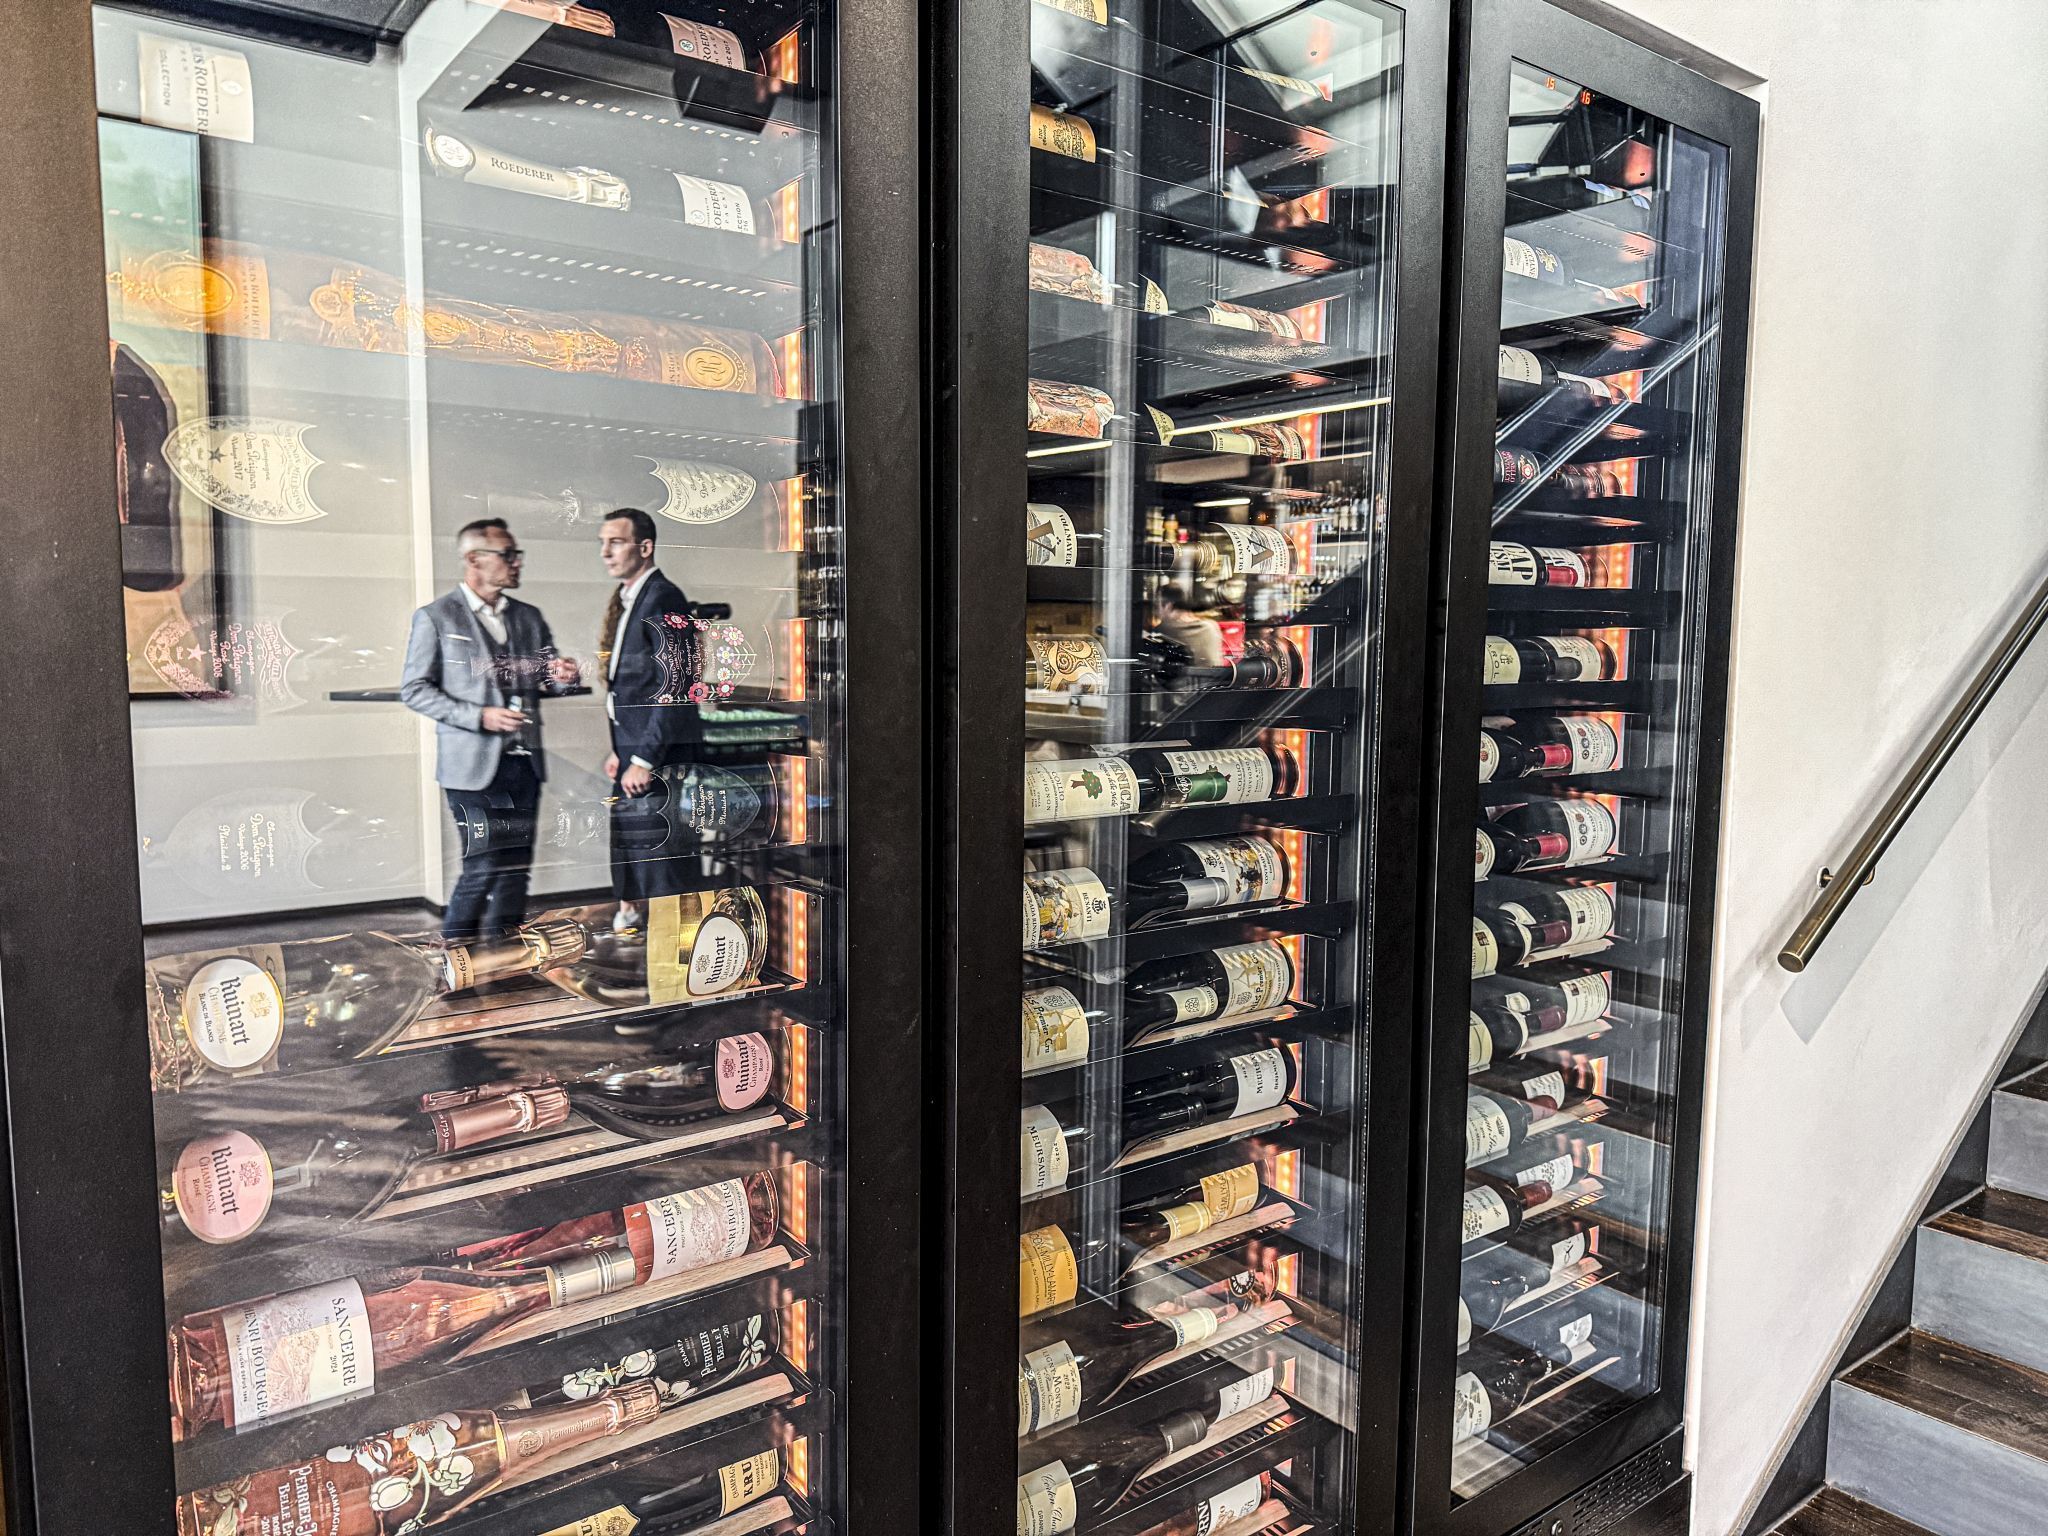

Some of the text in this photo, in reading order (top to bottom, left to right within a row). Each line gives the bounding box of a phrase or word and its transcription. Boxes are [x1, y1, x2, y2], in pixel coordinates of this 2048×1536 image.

[159, 49, 171, 106] COLLECTION
[1580, 91, 1591, 104] 16
[491, 157, 555, 182] ROEDERER
[234, 460, 244, 481] 2017
[1059, 514, 1075, 566] VOLLMAYER
[1501, 545, 1533, 580] CAP
[229, 623, 243, 645] Dom
[245, 630, 255, 676] Champagne
[693, 663, 702, 682] Dom
[1051, 771, 1065, 802] COLLIO
[1104, 758, 1133, 811] VENICA
[250, 813, 264, 838] Dom
[689, 792, 698, 828] Champagne
[696, 812, 706, 834] Dom
[237, 824, 249, 871] Vintage 2006
[266, 821, 275, 867] Champagne
[473, 822, 485, 839] P2
[1082, 892, 1092, 923] BENANTI
[457, 954, 467, 971] 1729
[705, 936, 726, 985] Ruinart
[720, 940, 734, 981] CHAMPAGNE
[1256, 965, 1264, 994] Premier
[220, 977, 250, 1046] Ruinart
[1034, 1007, 1053, 1054] Premier Cru
[735, 1040, 751, 1094] Ruinart
[440, 1120, 450, 1138] 1729
[1027, 1126, 1045, 1188] MEURSAULT
[200, 1156, 217, 1214] CHAMPAGNE
[212, 1146, 240, 1215] Ruinart
[331, 1297, 359, 1387] SANCERRE
[329, 1354, 338, 1373] 2024
[1063, 1374, 1071, 1390] 2022
[278, 1482, 292, 1521] BELLE
[1041, 1474, 1056, 1505] Corton
